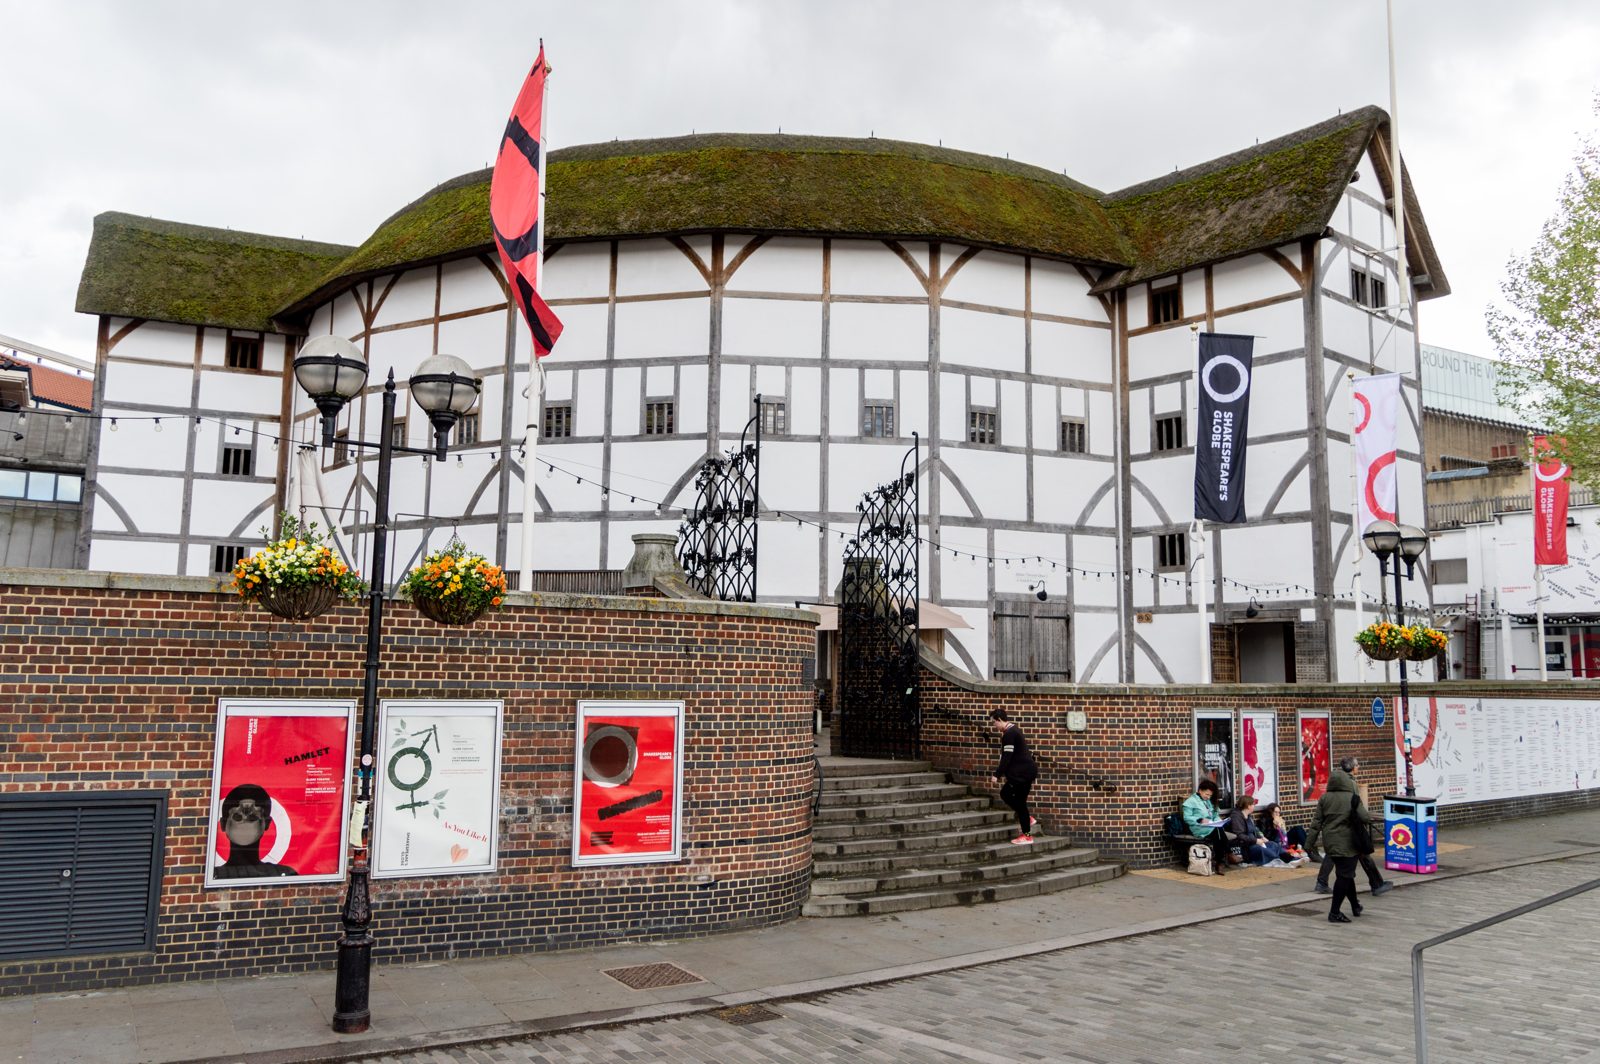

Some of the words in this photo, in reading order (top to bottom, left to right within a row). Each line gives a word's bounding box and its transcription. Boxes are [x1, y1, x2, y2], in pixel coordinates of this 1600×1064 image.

[1211, 410, 1222, 449] GLOBE
[1219, 411, 1233, 502] SHAKESPEARE'S
[1546, 487, 1555, 550] SHAKESPEARE'S
[246, 718, 254, 755] SHAKESPEARE'S
[284, 747, 330, 765] HAMLET
[444, 820, 452, 830] As
[453, 824, 466, 835] You
[466, 829, 481, 841] Like
[481, 834, 488, 843] It
